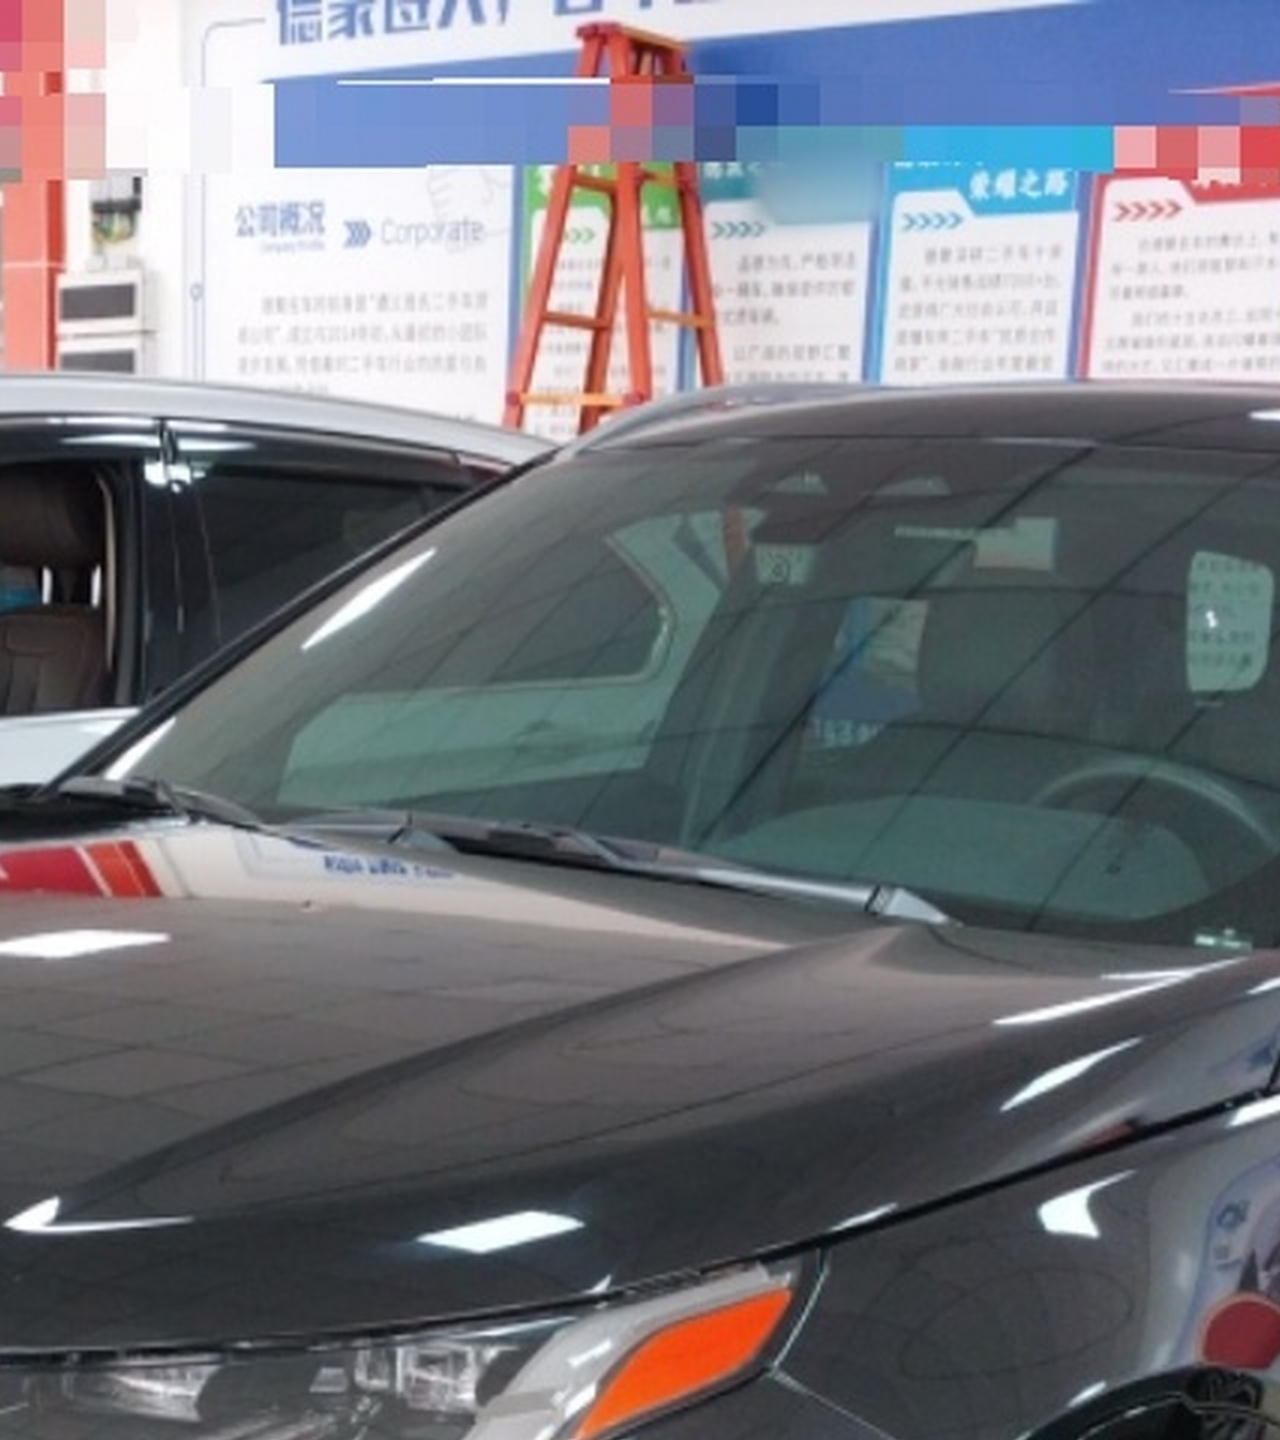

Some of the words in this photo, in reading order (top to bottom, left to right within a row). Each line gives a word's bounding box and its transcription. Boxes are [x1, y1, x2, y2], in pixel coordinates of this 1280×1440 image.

[235, 200, 325, 237] 公司概况
[381, 216, 485, 248] Corporate
